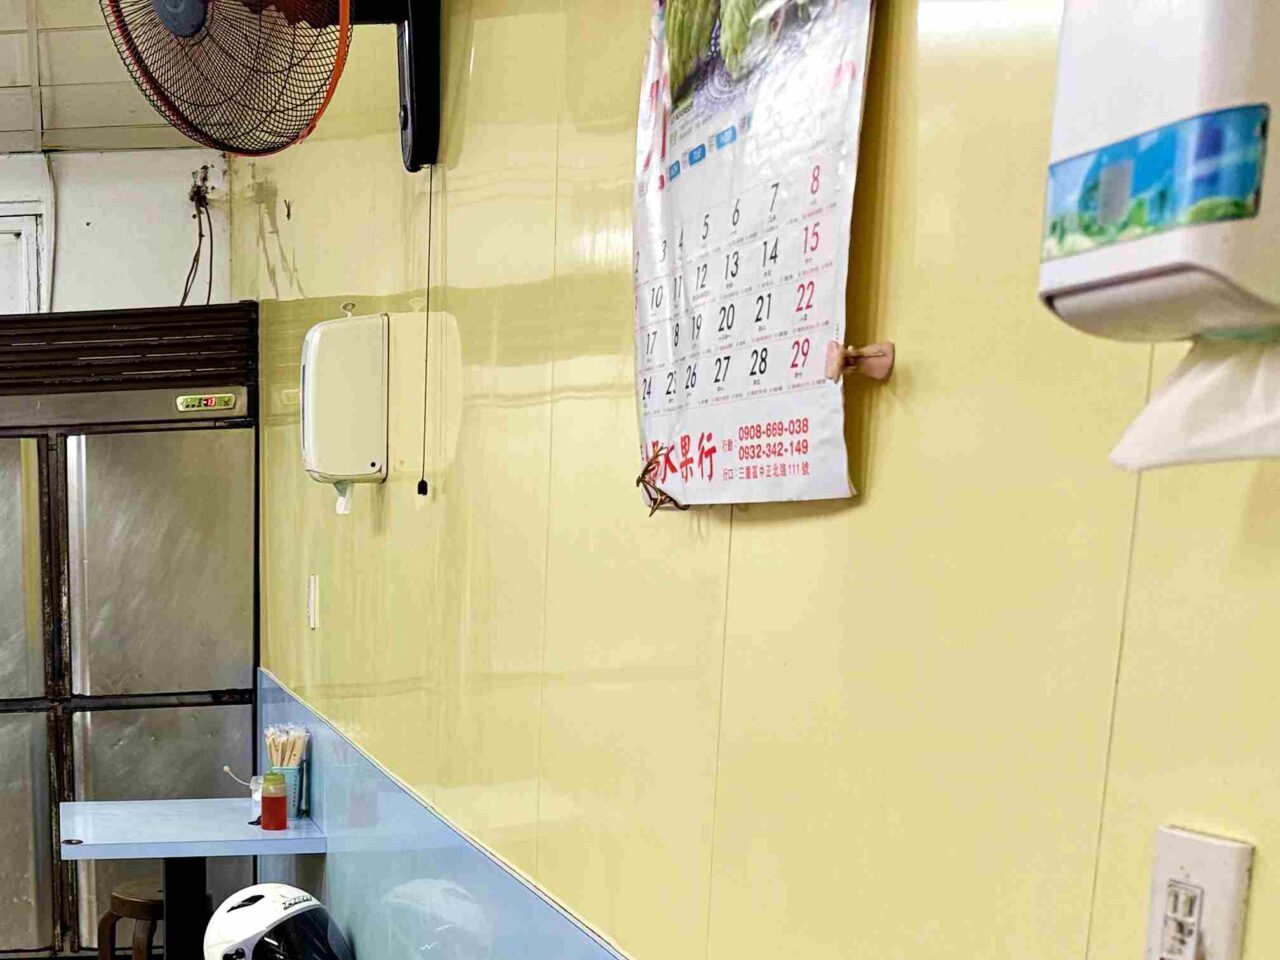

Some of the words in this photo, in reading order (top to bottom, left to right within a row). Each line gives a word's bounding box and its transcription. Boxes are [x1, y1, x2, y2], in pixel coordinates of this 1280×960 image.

[702, 214, 710, 240] 5
[732, 198, 740, 226] 6
[770, 182, 780, 212] 7
[810, 165, 820, 194] 8
[651, 285, 663, 309] 10
[695, 263, 708, 291] 12
[724, 251, 740, 281] 13
[762, 237, 779, 268] 14
[802, 222, 821, 255] 15
[646, 331, 658, 356] 17
[672, 323, 680, 348] 8
[691, 314, 703, 341] 19
[718, 303, 735, 333] 20
[754, 292, 772, 324] 21
[795, 280, 815, 313] 22
[642, 377, 652, 401] 24
[685, 363, 697, 390] 26
[713, 355, 731, 384] 27
[749, 347, 768, 377] 28
[790, 337, 810, 369] 29
[738, 417, 810, 441] 0908-669-038
[738, 438, 810, 461] 0932-342-149
